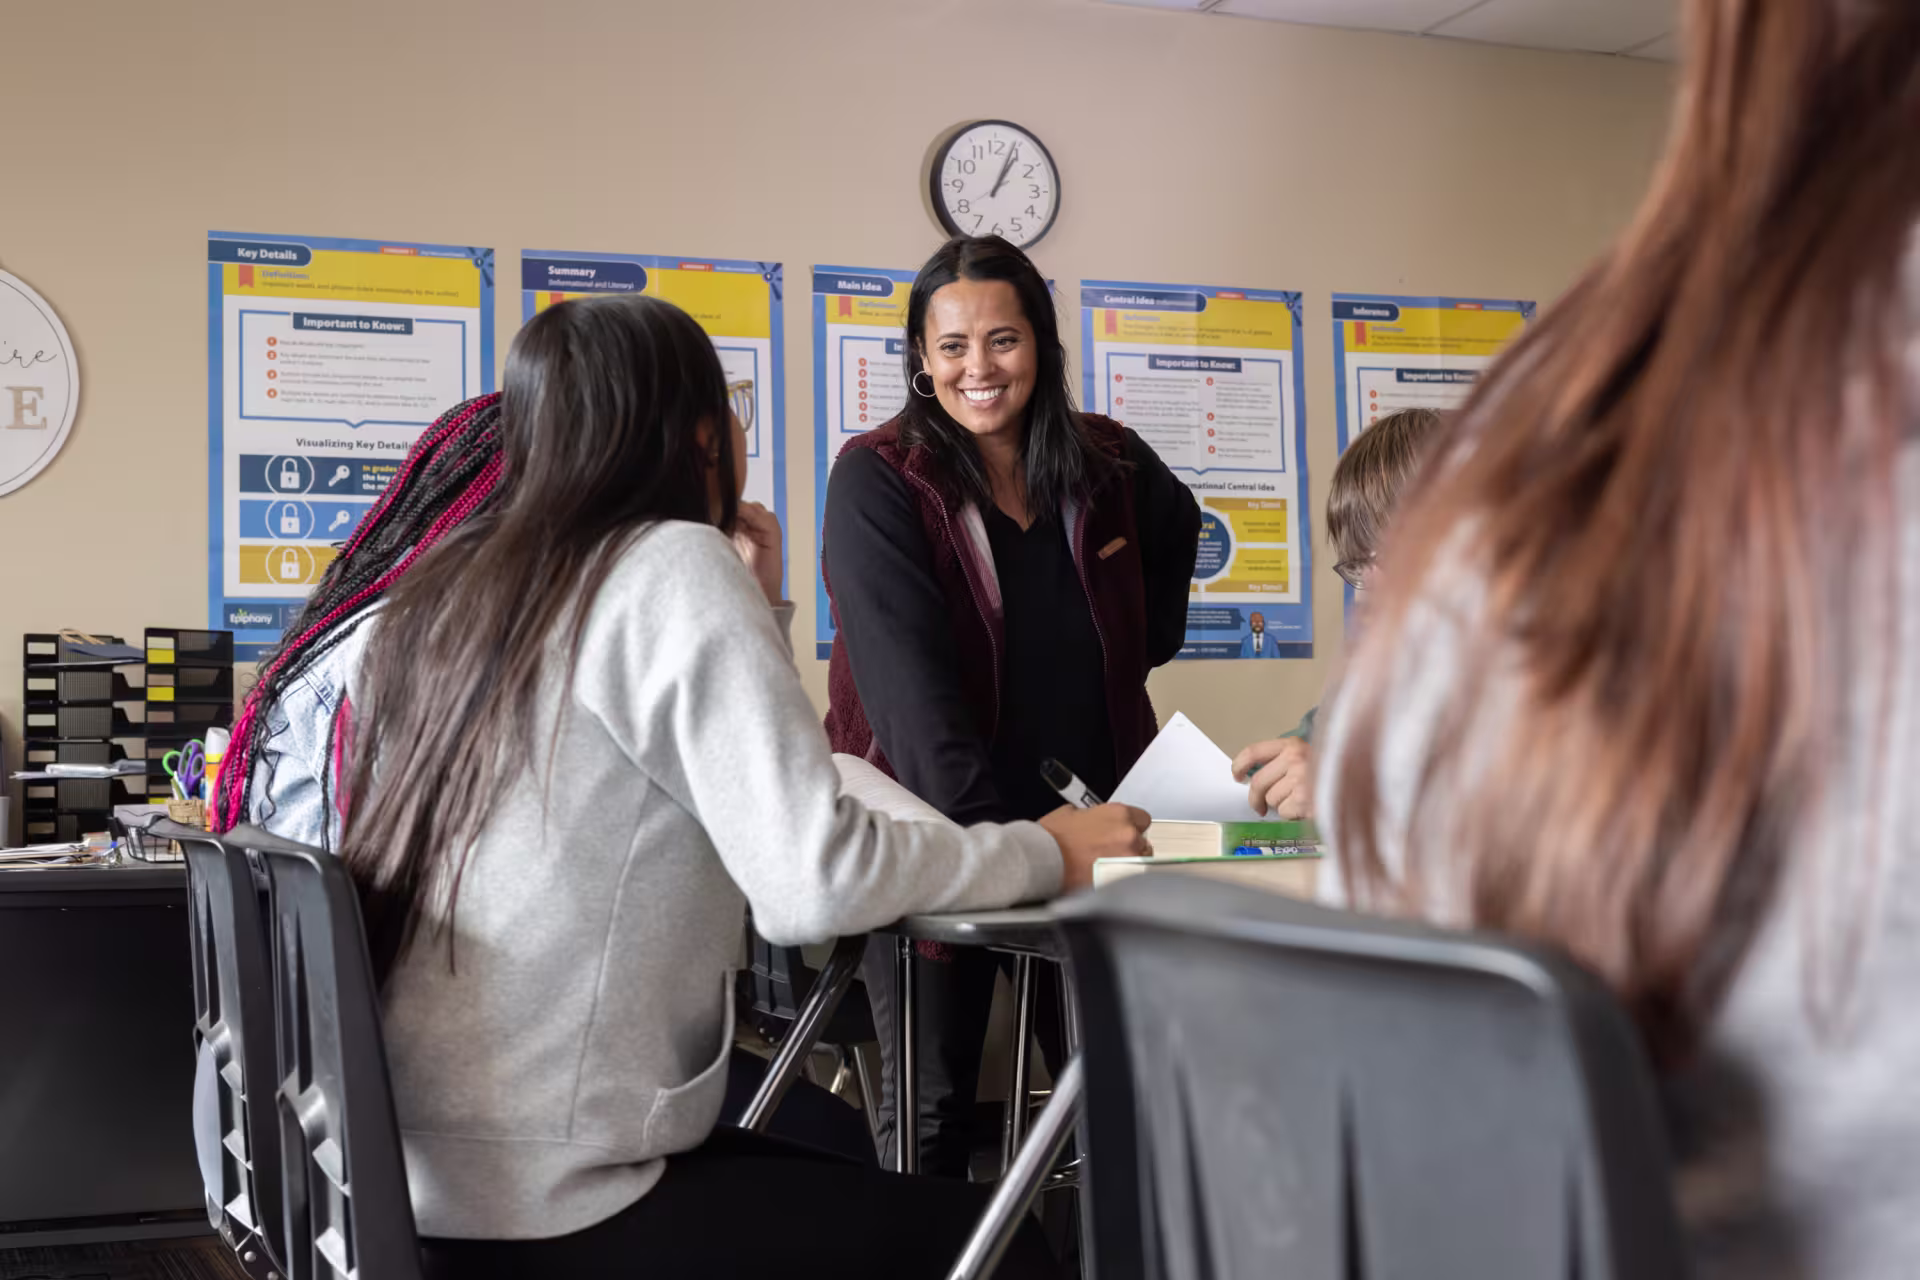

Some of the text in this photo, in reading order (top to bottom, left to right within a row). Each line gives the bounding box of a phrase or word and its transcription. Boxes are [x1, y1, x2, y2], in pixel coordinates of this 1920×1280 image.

[972, 145, 984, 160] 11
[987, 140, 1006, 156] 12
[957, 160, 976, 175] 10
[1022, 164, 1034, 179] 2
[951, 179, 964, 193] 9
[1028, 184, 1041, 199] 3
[957, 199, 970, 214] 8
[1024, 204, 1036, 219] 4
[973, 214, 984, 229] 7
[1010, 217, 1023, 232] 5
[991, 222, 1004, 237] 6
[237, 247, 297, 261] Key Details
[547, 265, 596, 279] Summary
[837, 280, 882, 292] Main Idea
[1104, 295, 1136, 305] Central
[1136, 295, 1155, 305] Idea
[303, 316, 406, 332] Important to Know:
[1155, 357, 1236, 370] Important to Know:
[296, 438, 354, 450] Visualizing
[356, 440, 375, 451] Key
[1227, 482, 1257, 491] Central
[1257, 483, 1276, 492] Idea
[229, 612, 272, 625] Epiphany
[1274, 846, 1298, 855] EXPO
